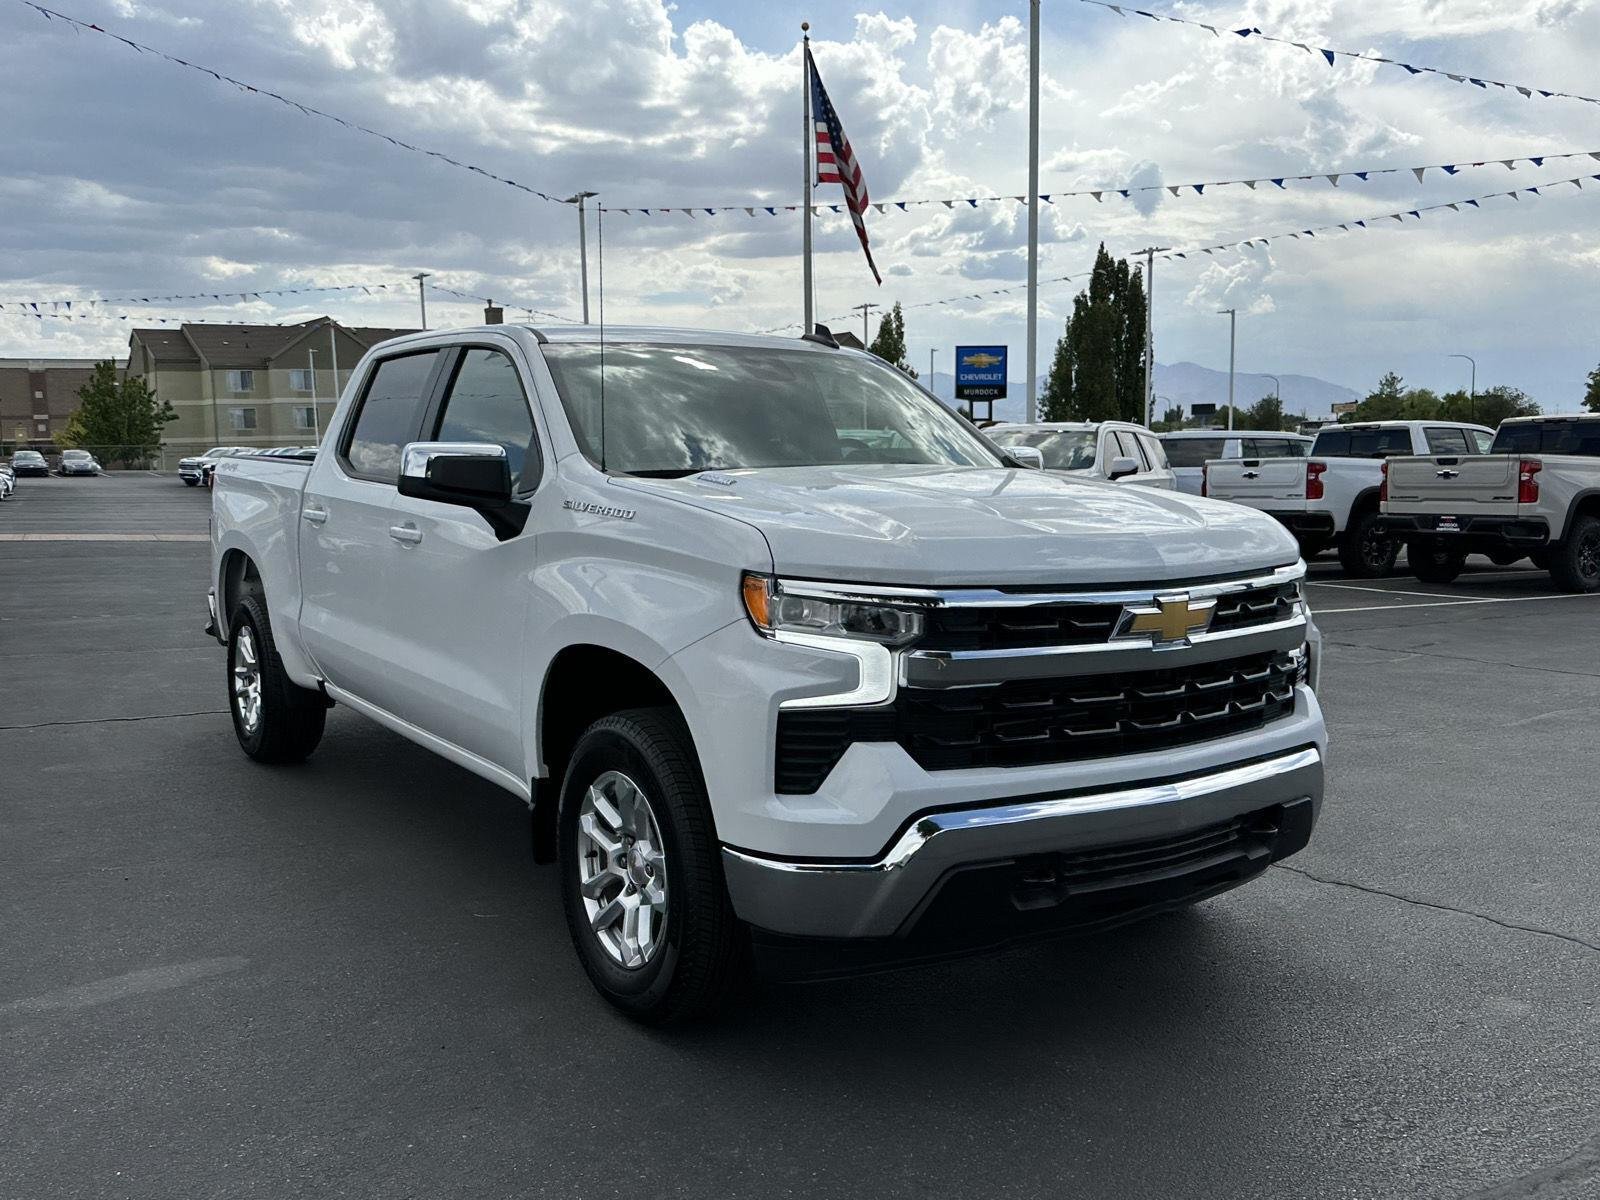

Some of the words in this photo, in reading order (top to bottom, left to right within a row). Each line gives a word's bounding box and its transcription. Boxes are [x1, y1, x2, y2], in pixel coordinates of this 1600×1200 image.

[960, 373, 1003, 381] CHEVROLET
[963, 388, 999, 396] MURDOCK
[562, 500, 637, 520] SILVERADO
